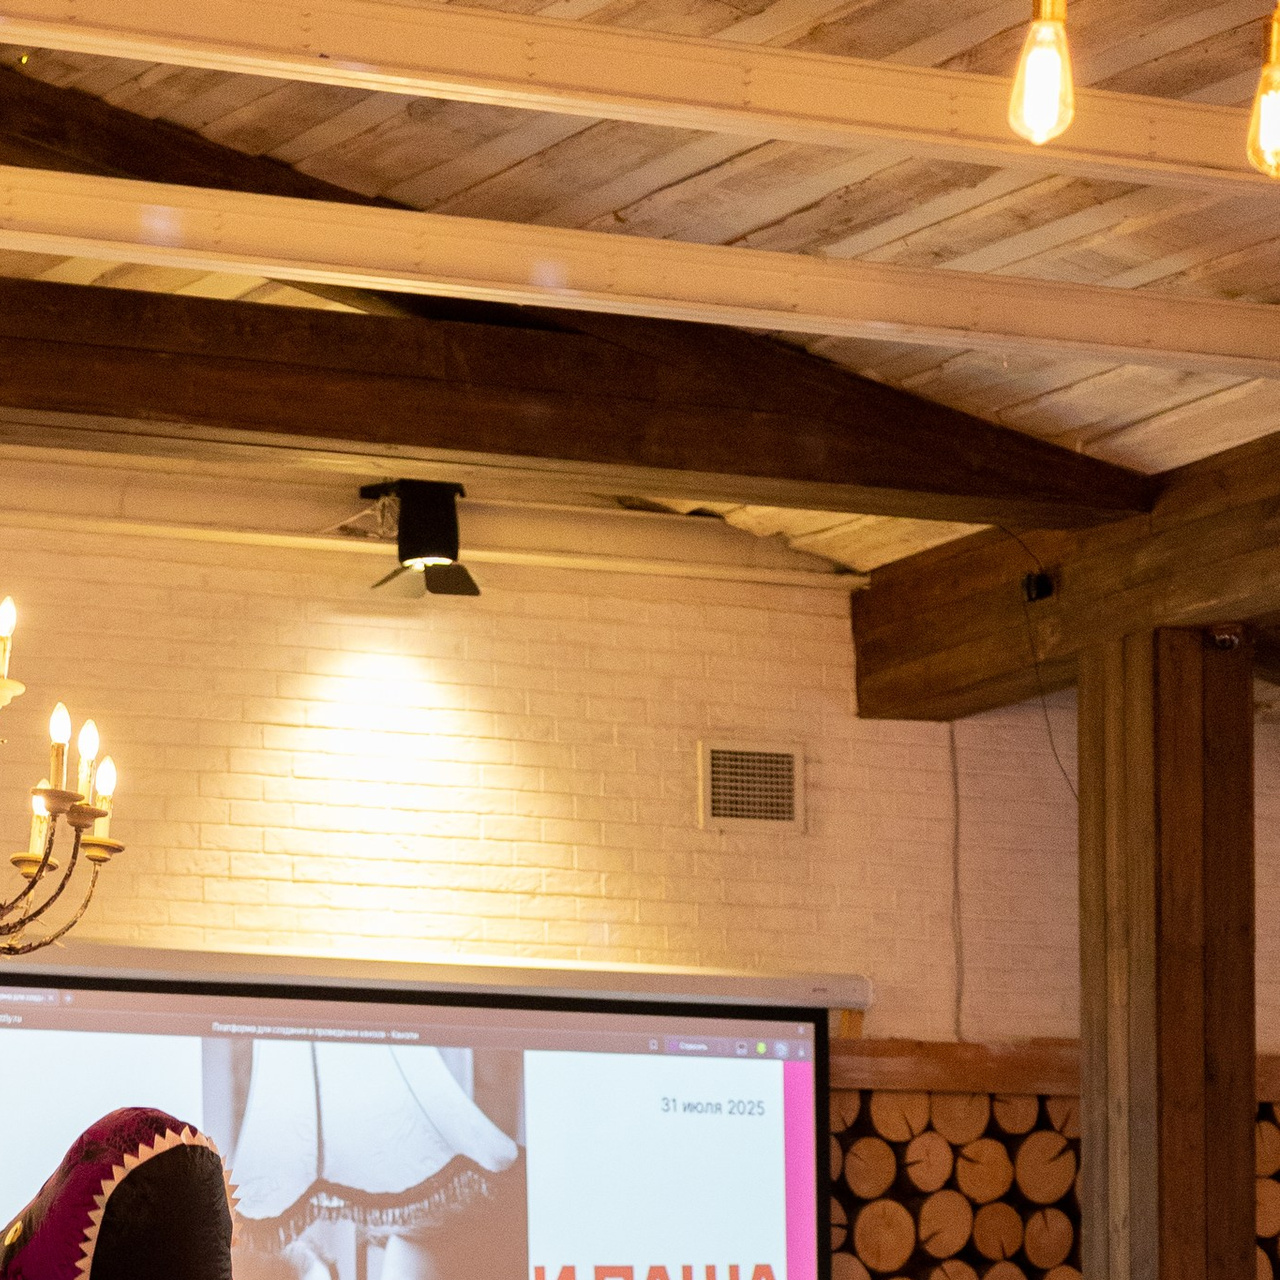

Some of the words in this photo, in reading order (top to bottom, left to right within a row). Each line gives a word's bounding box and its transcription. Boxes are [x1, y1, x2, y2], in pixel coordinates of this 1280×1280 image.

[661, 1097, 677, 1112] 31
[683, 1102, 723, 1114] июля
[728, 1099, 765, 1116] 2025
